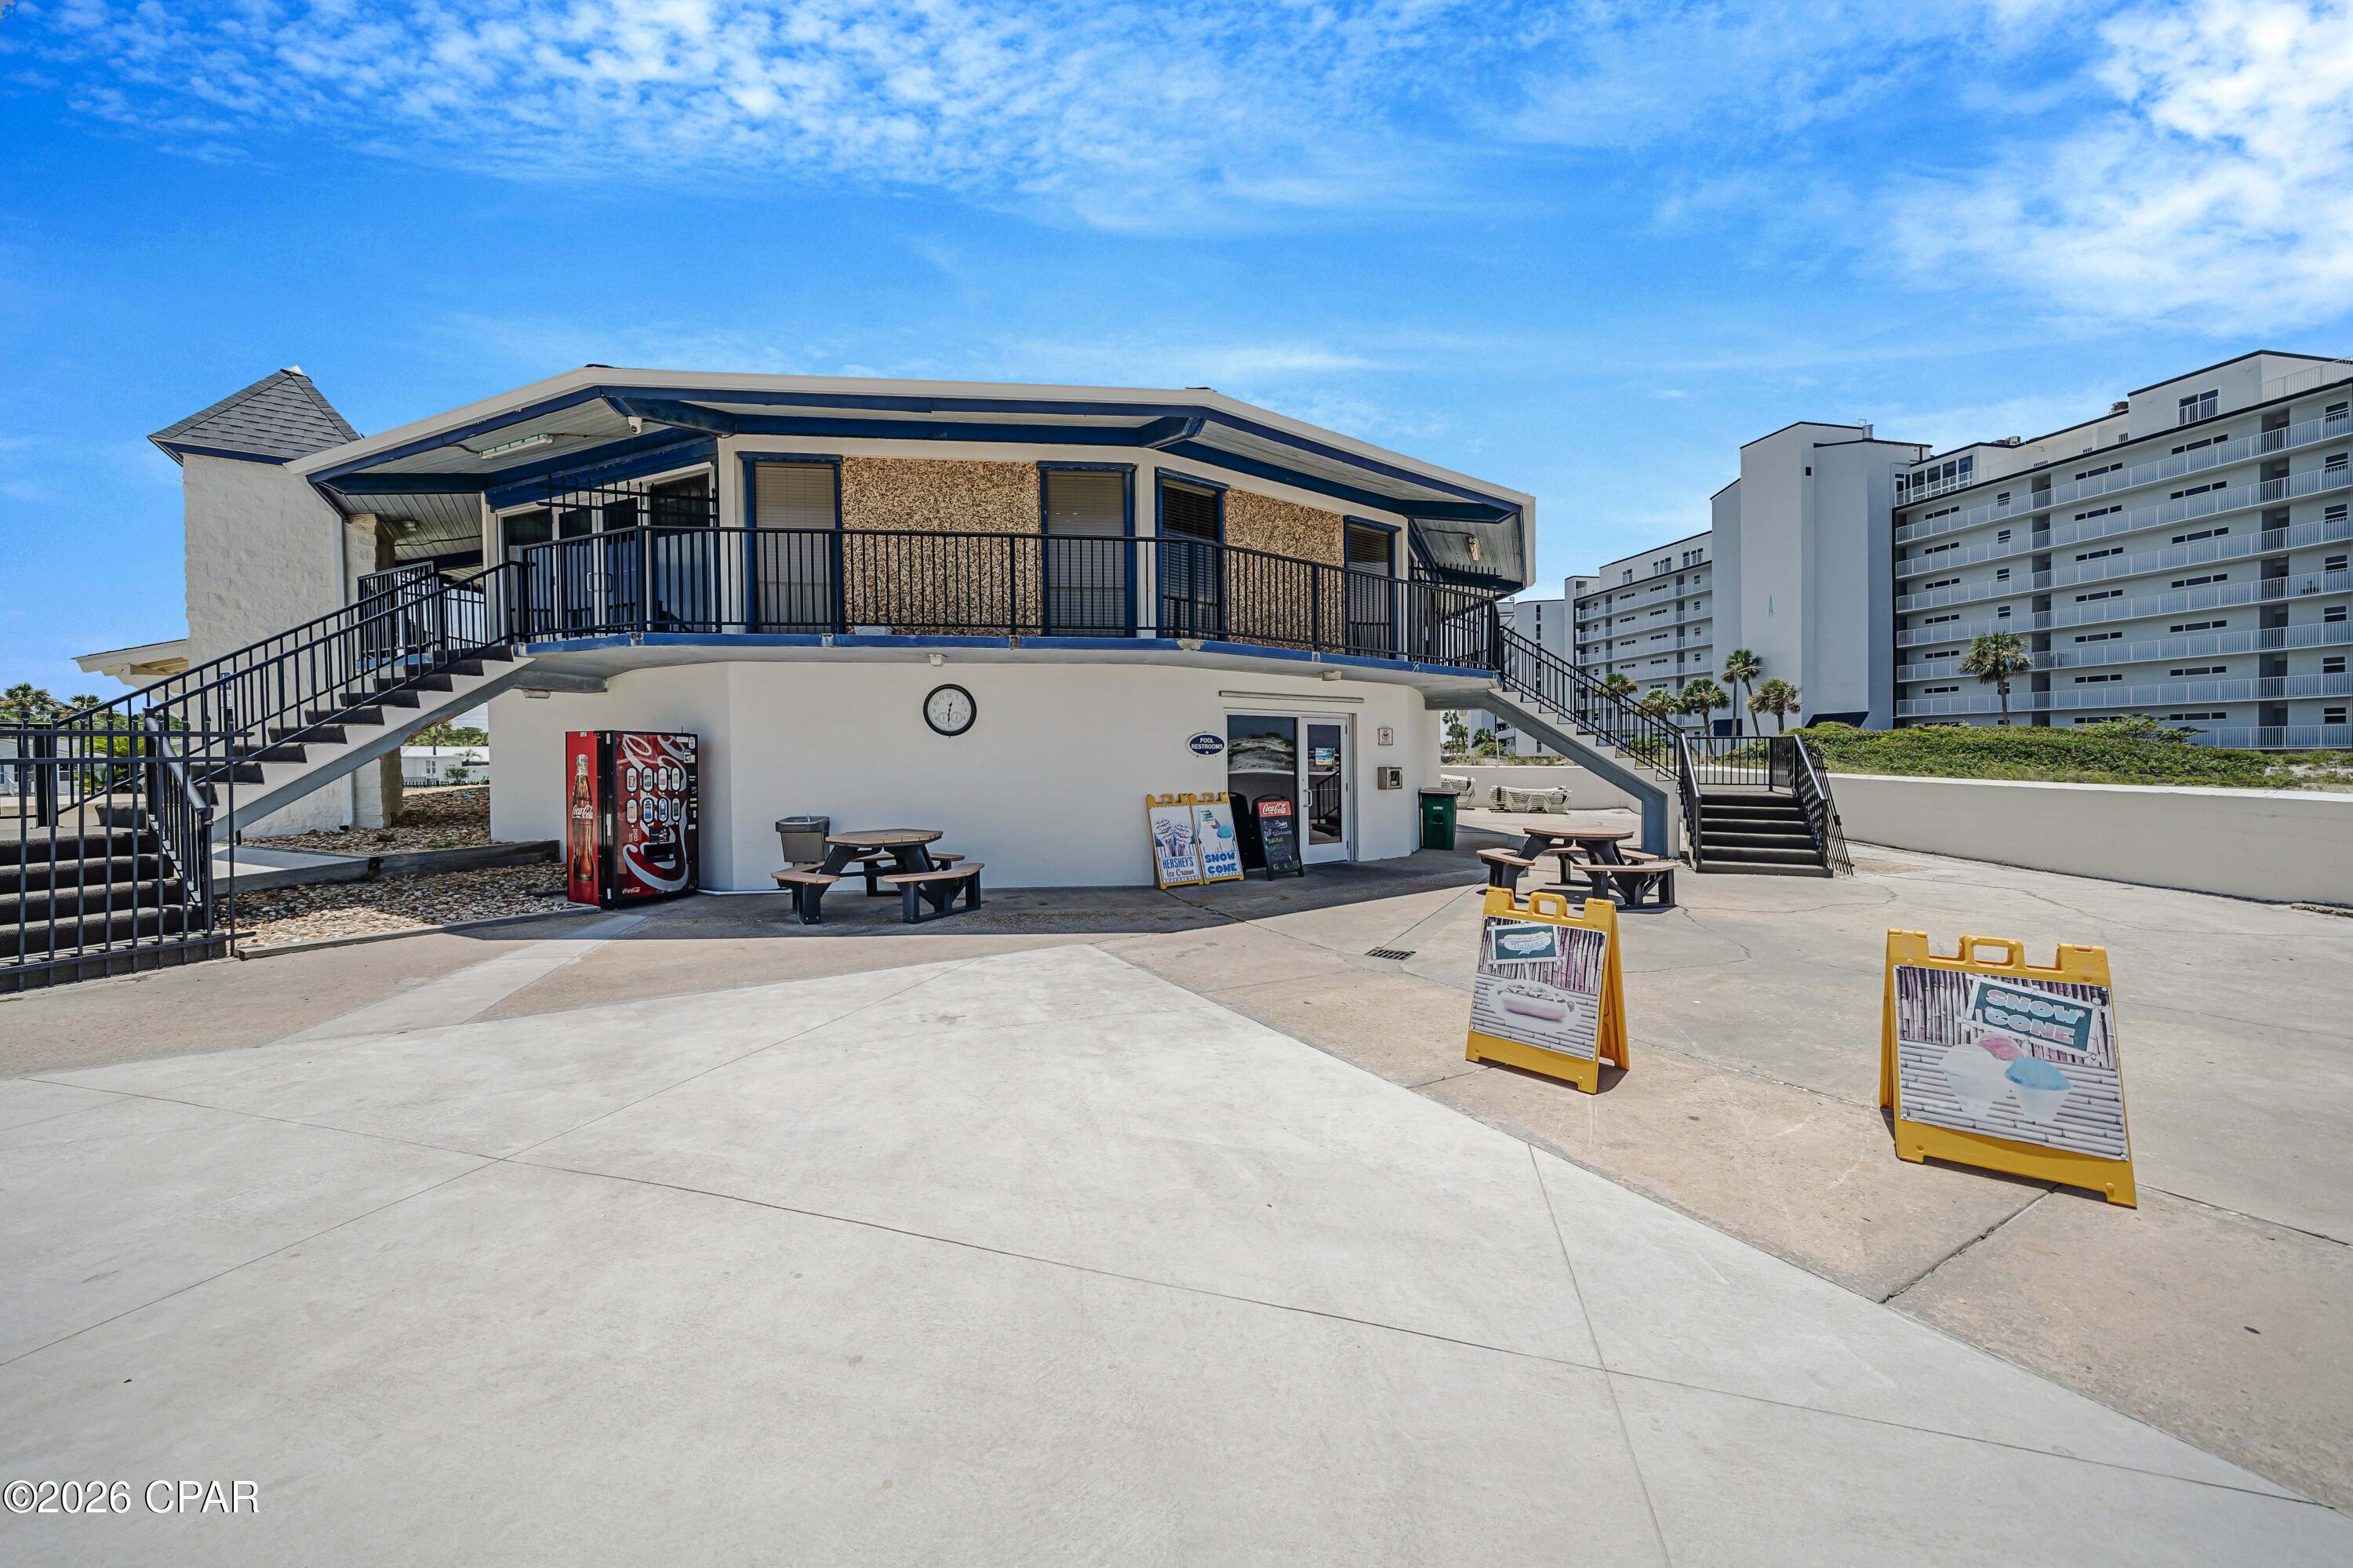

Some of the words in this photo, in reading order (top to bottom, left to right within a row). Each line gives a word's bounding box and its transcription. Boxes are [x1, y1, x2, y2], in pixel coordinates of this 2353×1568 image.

[1162, 856, 1195, 870] HERSHEY'S
[1204, 852, 1235, 864] SNOW
[1176, 868, 1195, 876] Cream
[1207, 863, 1238, 875] CONE
[1985, 989, 2082, 1024] SNOW
[1984, 1006, 2075, 1045] CONE
